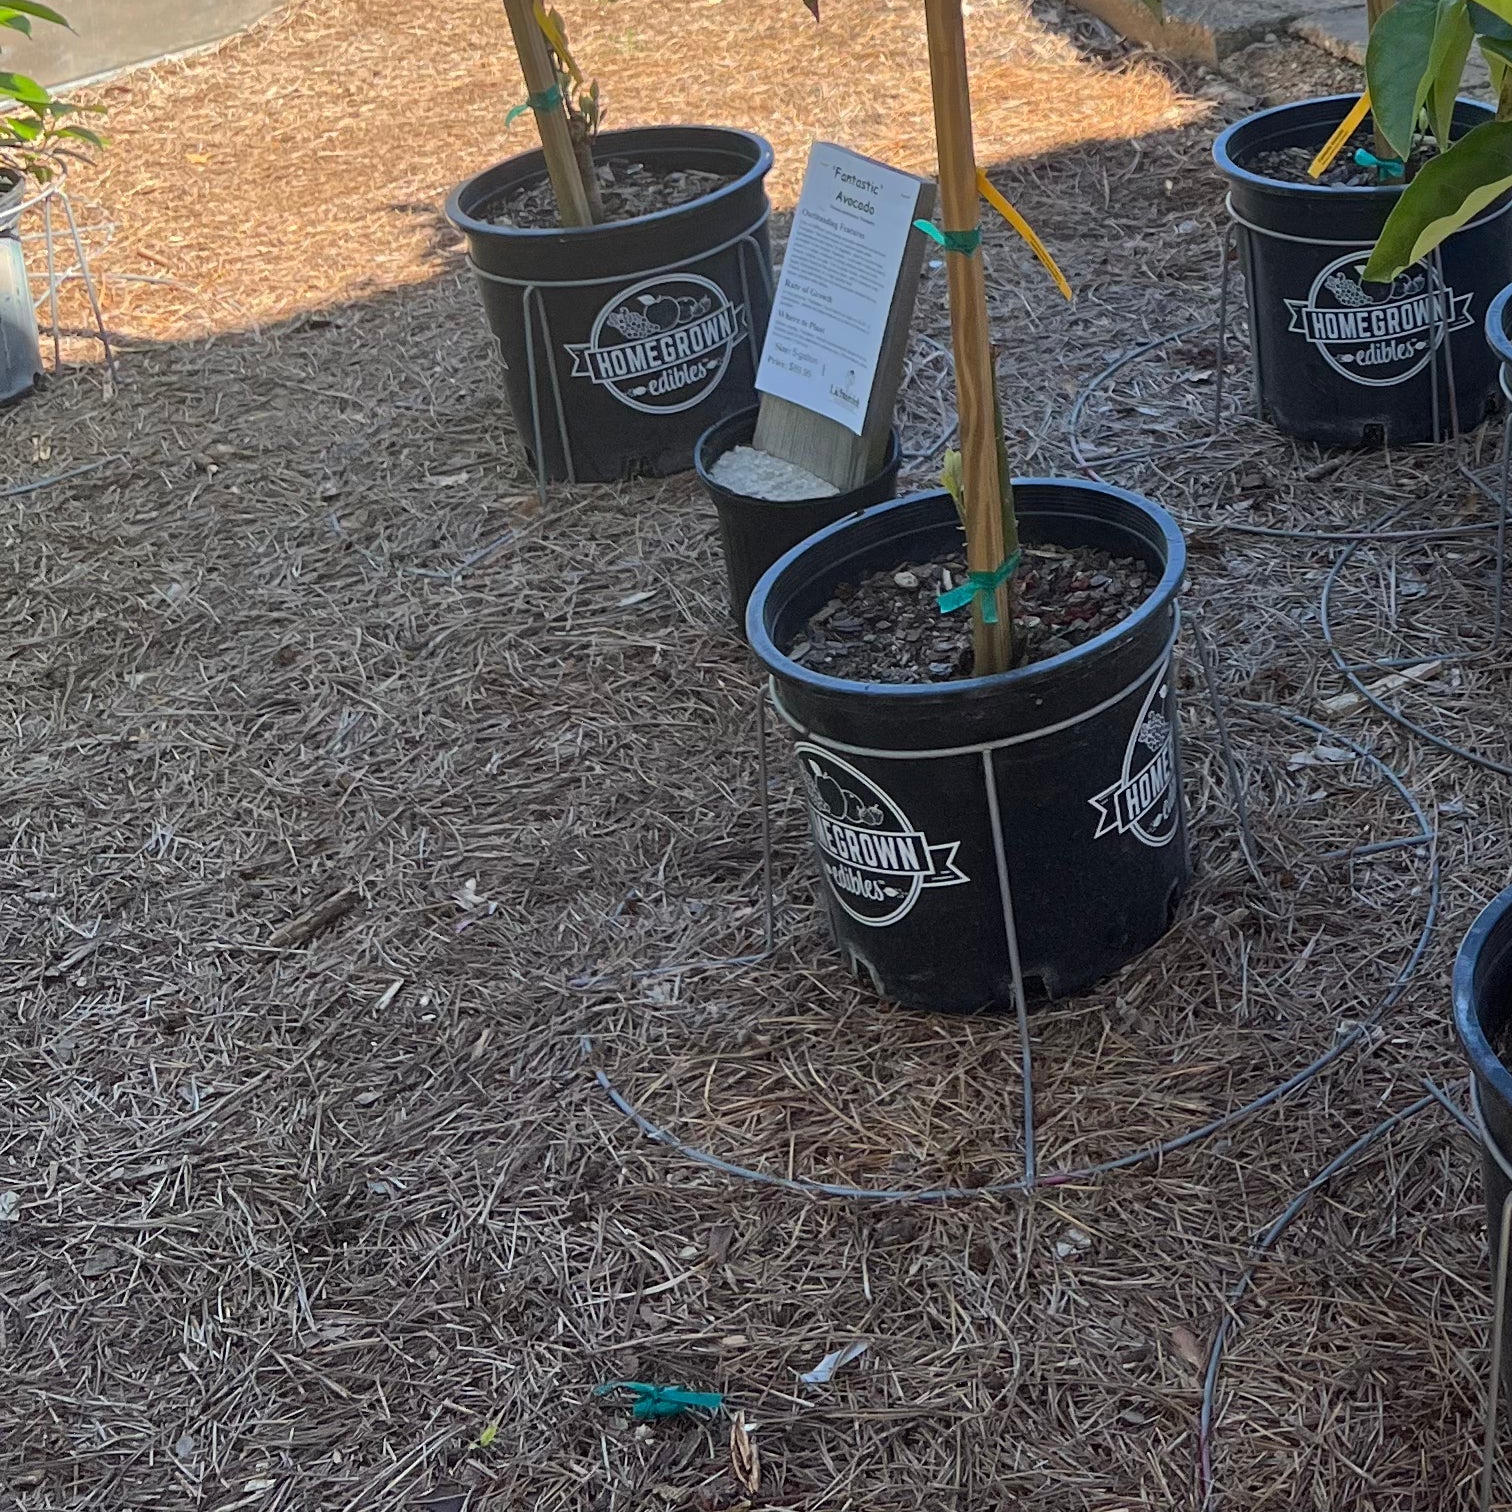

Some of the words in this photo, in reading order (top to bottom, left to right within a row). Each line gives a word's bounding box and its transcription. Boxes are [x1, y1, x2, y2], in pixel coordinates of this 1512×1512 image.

[836, 191, 875, 215] Avocado
[1312, 294, 1445, 339] HOMEGROWN
[595, 311, 733, 378] HOMEGROWN
[1356, 340, 1415, 366] edibles
[649, 362, 708, 396] edibles
